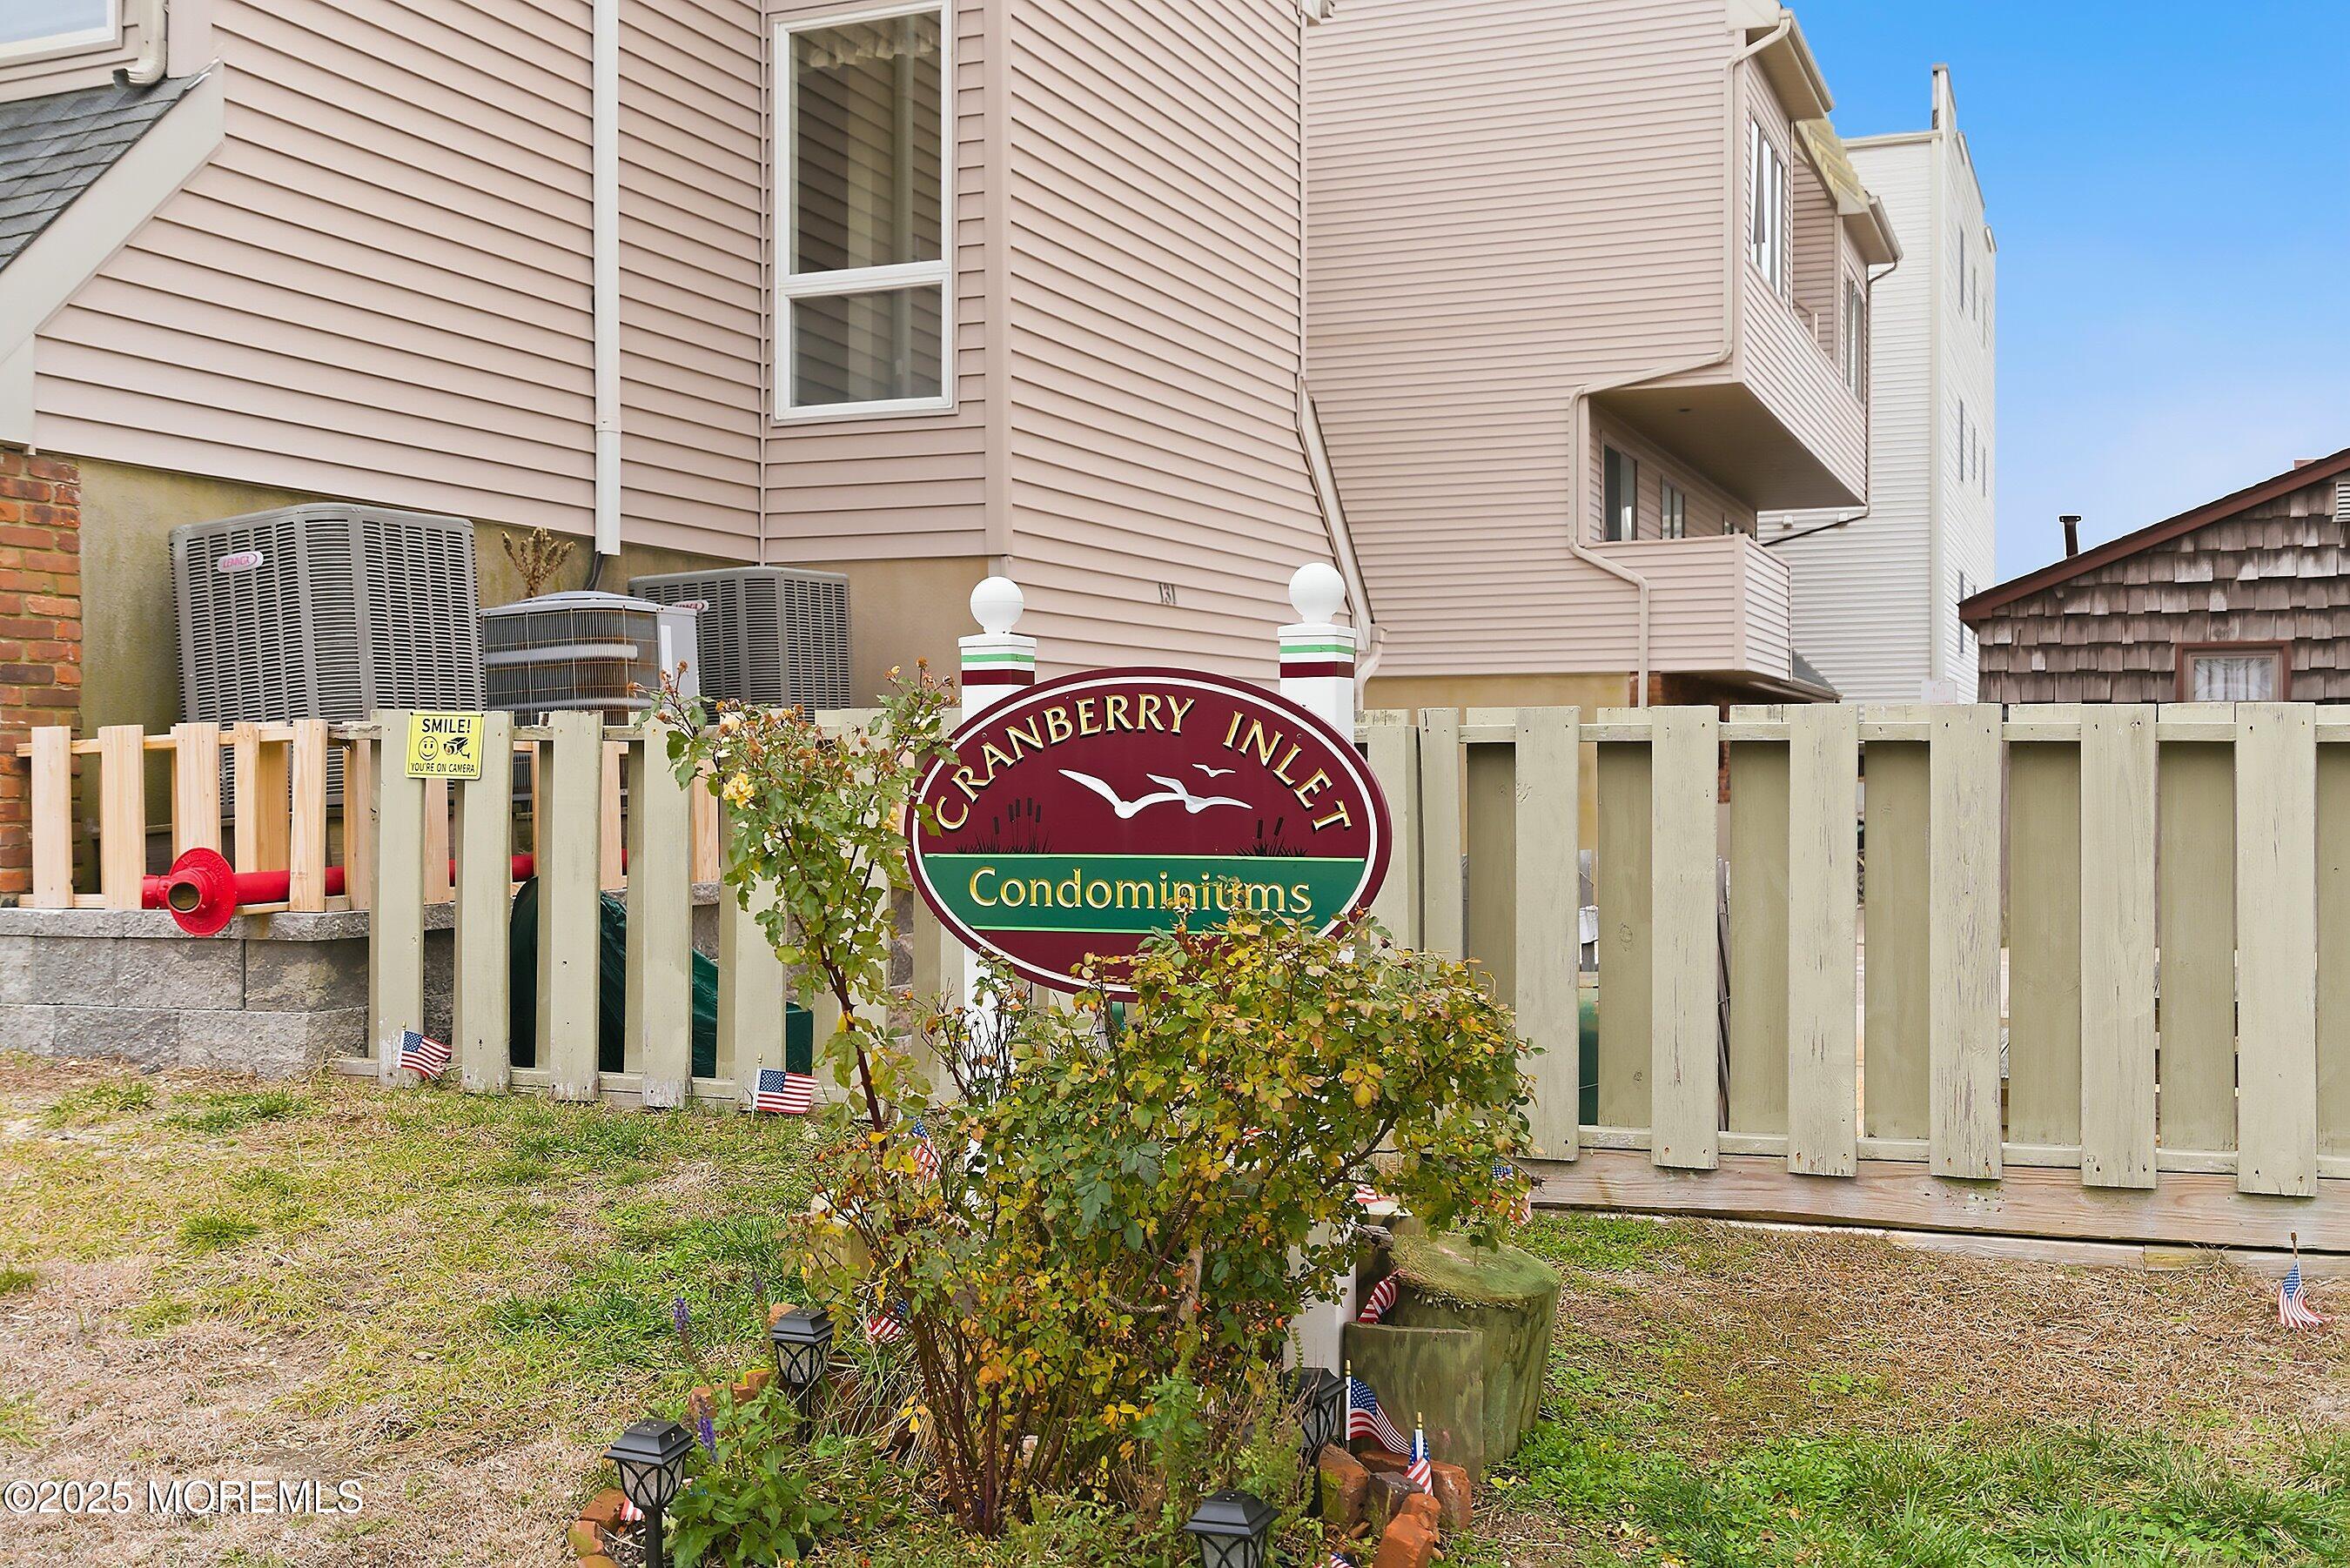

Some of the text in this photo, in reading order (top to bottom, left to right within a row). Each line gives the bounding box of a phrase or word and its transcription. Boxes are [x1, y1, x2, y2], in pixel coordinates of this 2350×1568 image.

[1158, 582, 1176, 605] 131
[421, 718, 471, 734] SMILE!
[411, 762, 475, 774] YOU'RE ON CAMERA
[936, 694, 1353, 831] CRANBERRY INLET
[969, 866, 1313, 914] Condominiums
